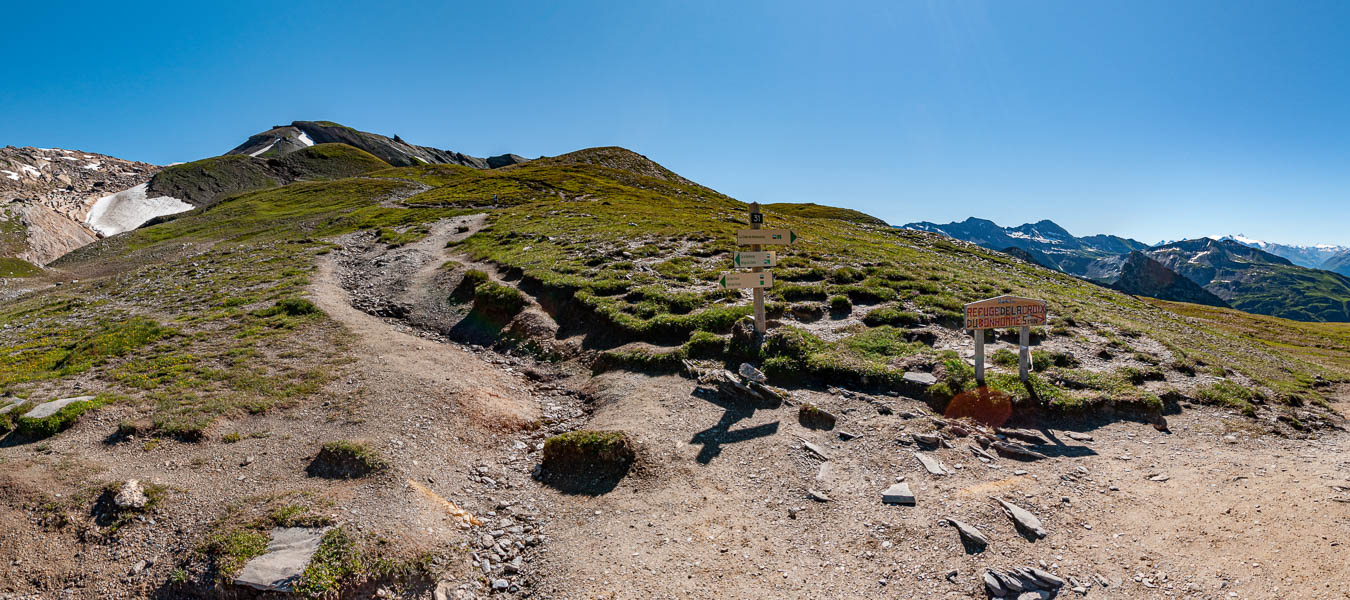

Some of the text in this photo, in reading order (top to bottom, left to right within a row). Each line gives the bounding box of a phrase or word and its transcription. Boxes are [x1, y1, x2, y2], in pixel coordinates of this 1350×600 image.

[753, 214, 761, 222] 31
[967, 304, 1045, 317] REFUGE DE LA CROIX
[967, 318, 978, 328] DU
